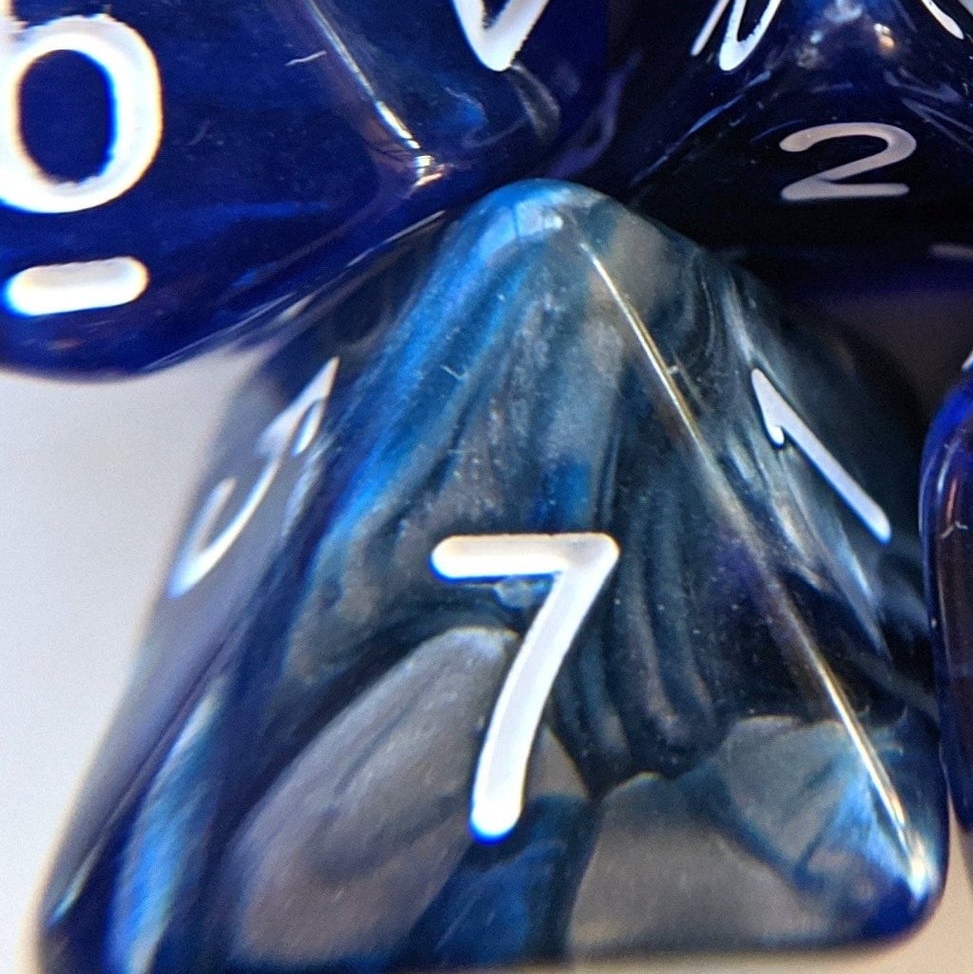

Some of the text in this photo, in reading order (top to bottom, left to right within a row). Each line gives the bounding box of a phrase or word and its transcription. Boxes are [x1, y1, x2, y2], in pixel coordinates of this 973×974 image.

[780, 122, 917, 201] 2
[752, 367, 892, 544] 1
[430, 532, 620, 840] 7
